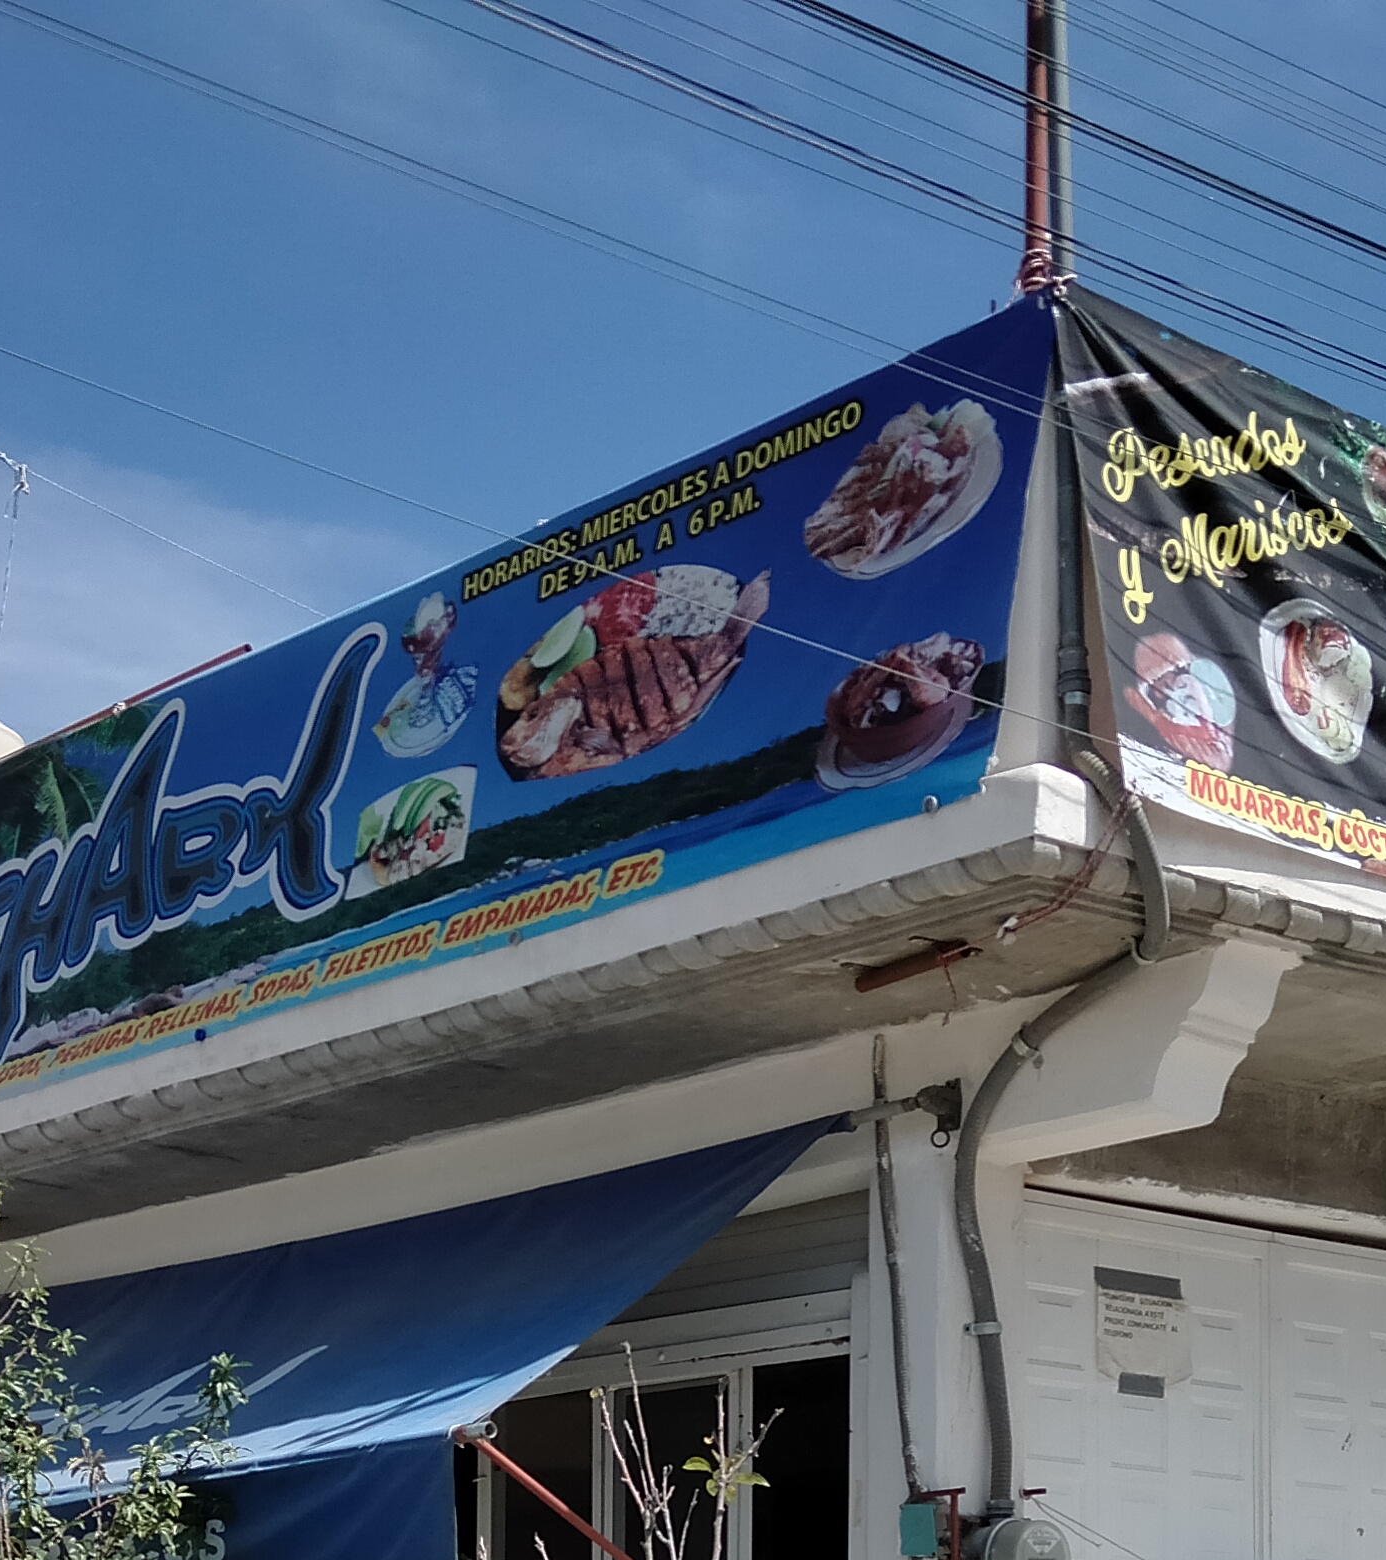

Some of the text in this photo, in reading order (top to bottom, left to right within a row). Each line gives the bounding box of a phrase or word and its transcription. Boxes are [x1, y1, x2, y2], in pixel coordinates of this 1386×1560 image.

[462, 401, 862, 599] HORARIOS: MIERCOLES A DOMINGO
[1102, 411, 1307, 502] Pescados
[539, 487, 762, 600] DE 9 A.M. A 6 P.M.
[1119, 498, 1354, 624] y Mariscos
[1190, 769, 1328, 843] MOJARRAS,
[48, 1021, 145, 1068] PECHUGAS
[143, 989, 242, 1039] RELLENAS,
[247, 962, 317, 1006] SOPAS,
[322, 927, 437, 982] FILETITOS,
[442, 873, 598, 944] EMPANADAS,
[606, 856, 661, 892] ETC.
